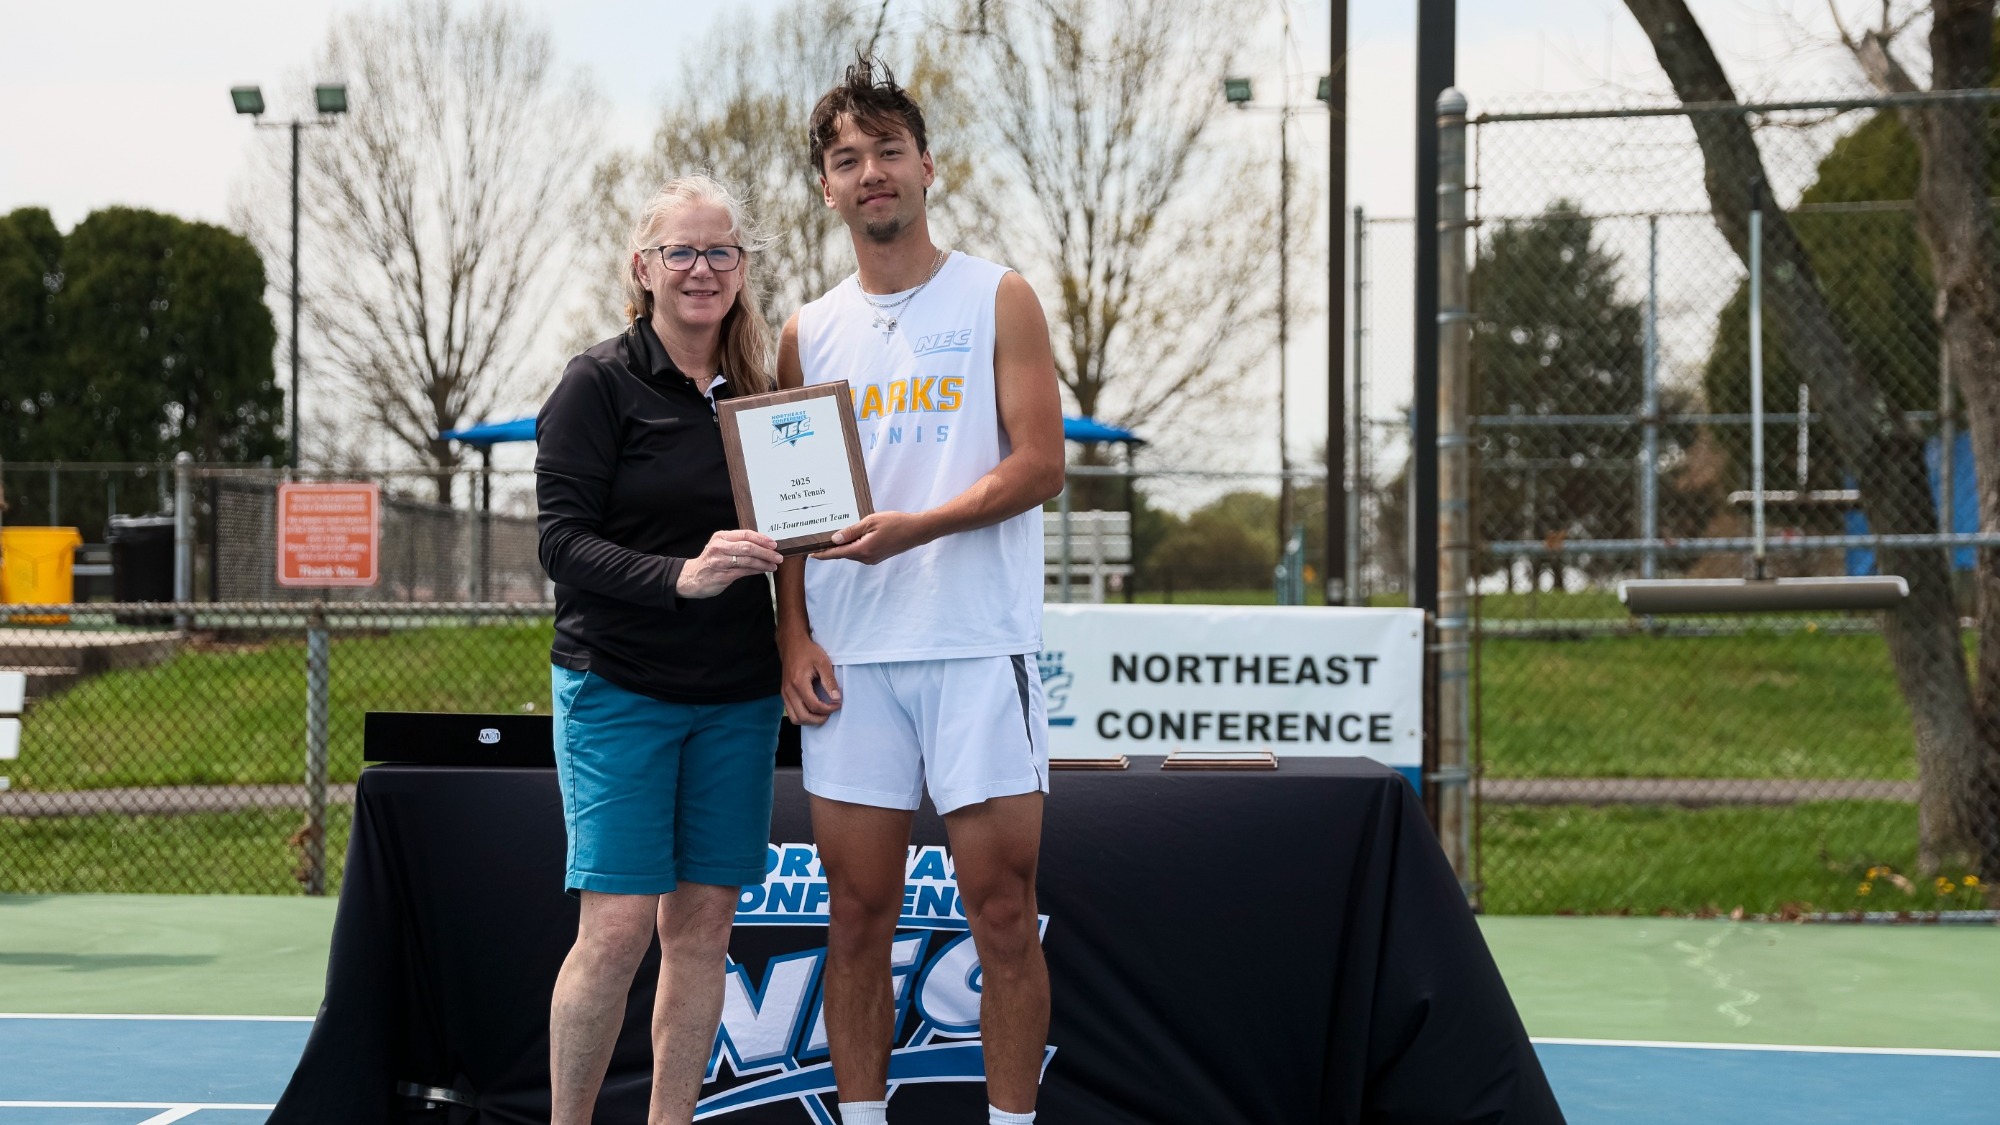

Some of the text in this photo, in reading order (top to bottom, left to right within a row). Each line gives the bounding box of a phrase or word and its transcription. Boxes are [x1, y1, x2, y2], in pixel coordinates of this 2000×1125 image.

[914, 328, 972, 354] NEC
[850, 376, 965, 421] ARKS
[771, 410, 806, 420] NORTHEAST
[772, 414, 807, 424] CONFERENCE
[771, 416, 811, 444] NEC
[870, 425, 949, 450] NNIS
[790, 476, 811, 487] 2025
[779, 487, 826, 502] Men's Tennis
[767, 512, 850, 533] All-Tournament Team
[1111, 653, 1379, 686] NORTHEAST
[1095, 710, 1393, 743] CONFERENCE
